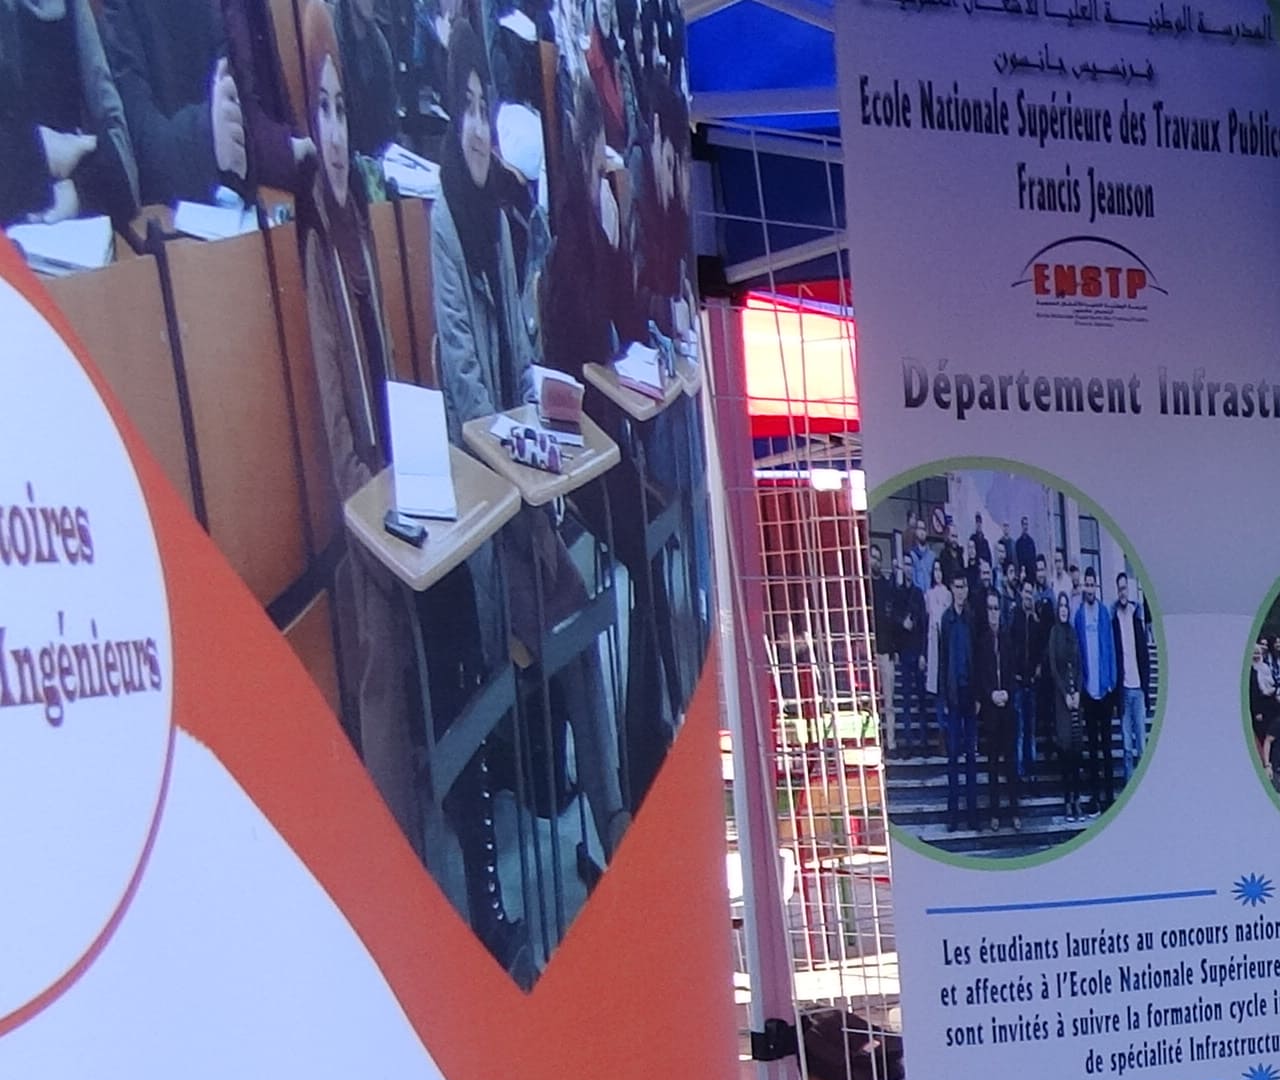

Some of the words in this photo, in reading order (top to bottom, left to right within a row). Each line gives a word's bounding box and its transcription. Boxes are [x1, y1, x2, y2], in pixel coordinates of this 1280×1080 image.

[859, 75, 911, 128] Ecole
[918, 79, 1010, 136] Nationale
[1017, 88, 1113, 148] Supérieure
[1119, 97, 1147, 147] des
[1153, 102, 1222, 153] Travaux
[1017, 161, 1081, 213] Francis
[1087, 167, 1155, 223] Jeanson
[1034, 263, 1147, 299] ENSTP
[901, 357, 1142, 421] Département
[942, 938, 971, 966] Les
[980, 934, 1059, 965] étudiants
[1066, 928, 1129, 959] lauréats
[1136, 932, 1153, 951] au
[1161, 924, 1228, 949] concours
[941, 984, 957, 1006] et
[966, 975, 1033, 1006] affectés
[1041, 973, 1050, 999] à
[1119, 961, 1194, 993] Nationale
[1201, 954, 1280, 987] Supérieure
[946, 1023, 984, 1047] sont
[992, 1013, 1049, 1043] invités
[1056, 1012, 1065, 1039] à
[1072, 1008, 1121, 1036] suivre
[1127, 1005, 1140, 1030] la
[1147, 997, 1223, 1028] formation
[1230, 992, 1267, 1023] cycle
[1085, 1048, 1103, 1075] de
[1110, 1038, 1183, 1076] spécialité
